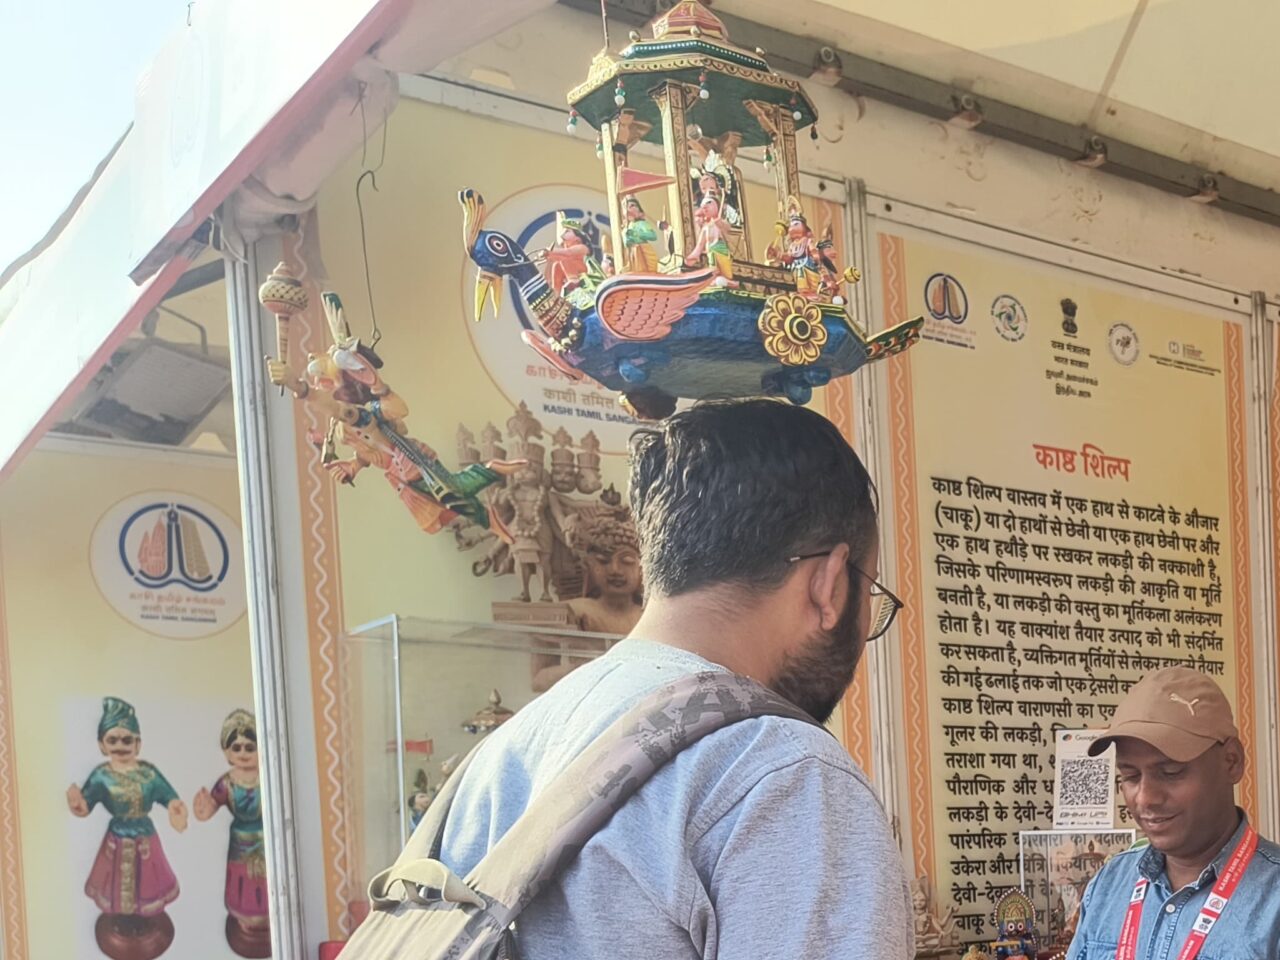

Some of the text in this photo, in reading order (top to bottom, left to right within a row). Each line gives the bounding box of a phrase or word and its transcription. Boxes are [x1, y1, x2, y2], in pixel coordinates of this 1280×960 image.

[544, 404, 573, 416] KASHI
[576, 409, 602, 421] TAMIL
[1032, 443, 1131, 481] काष्ठ शिल्प
[931, 476, 1219, 532] काष्ठ शिल्प वास्तव में एक हाथ से काटने के औजार
[935, 500, 1220, 556] (चाकू) या दो हाथों से छेनी या एक हाथ छेनी पर और
[933, 532, 960, 551] एक
[964, 536, 990, 555] हाथ
[994, 535, 1029, 562] हथौड़े
[1032, 544, 1049, 561] पर
[1053, 547, 1093, 566] रखकर
[1096, 549, 1134, 573] लकड़ी
[1137, 552, 1154, 572] की
[1157, 558, 1205, 578] नक्काशी
[935, 554, 1222, 607] जिसके परिणामस्वरूप लकड़ी की आकृति या मूर्ति
[936, 584, 1222, 627] बनती है, या लकड़ी की वस्तु का मूर्तिकला अलंकरण
[937, 610, 1223, 651] होता है। यह वाक्यांश तैयार उत्पाद को भी संदर्भित
